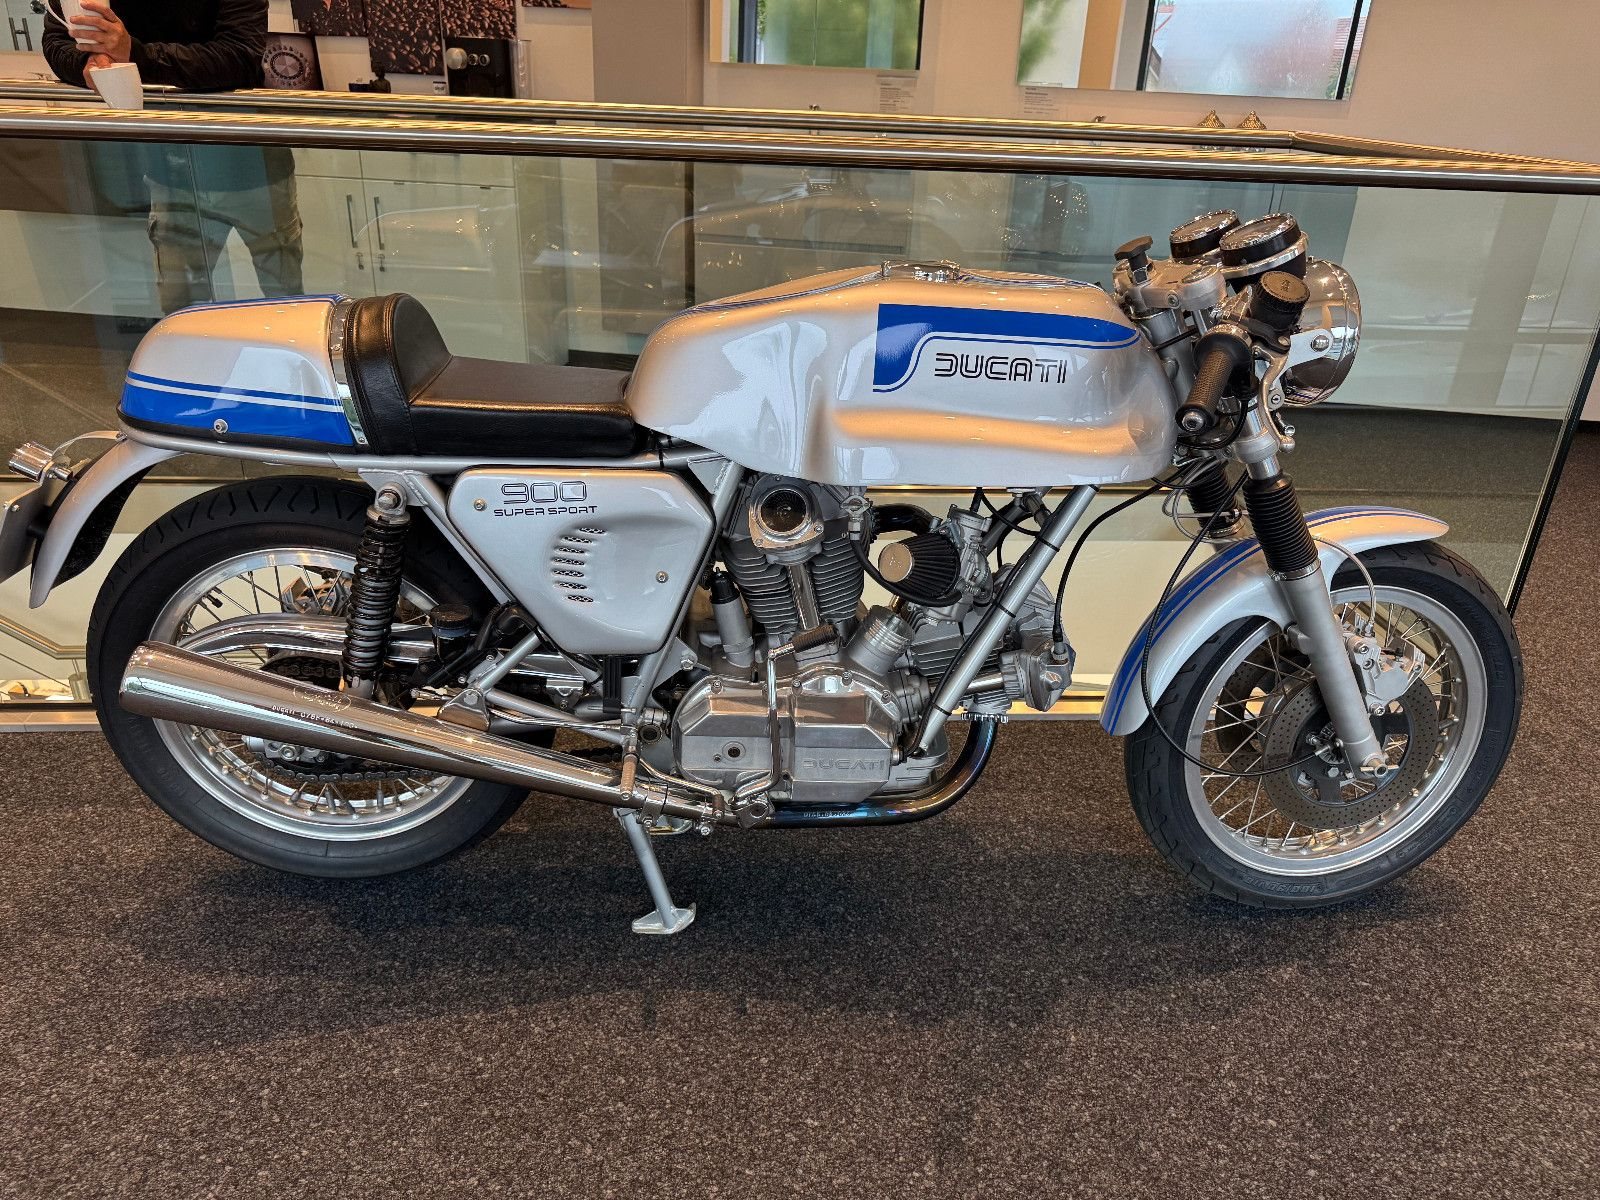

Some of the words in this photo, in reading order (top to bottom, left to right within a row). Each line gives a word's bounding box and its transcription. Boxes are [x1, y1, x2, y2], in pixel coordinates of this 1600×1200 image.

[934, 352, 1067, 384] DUCATI
[501, 481, 587, 504] 900
[493, 507, 545, 517] SUPER
[547, 505, 598, 515] SPORT
[802, 757, 885, 771] DUCATI
